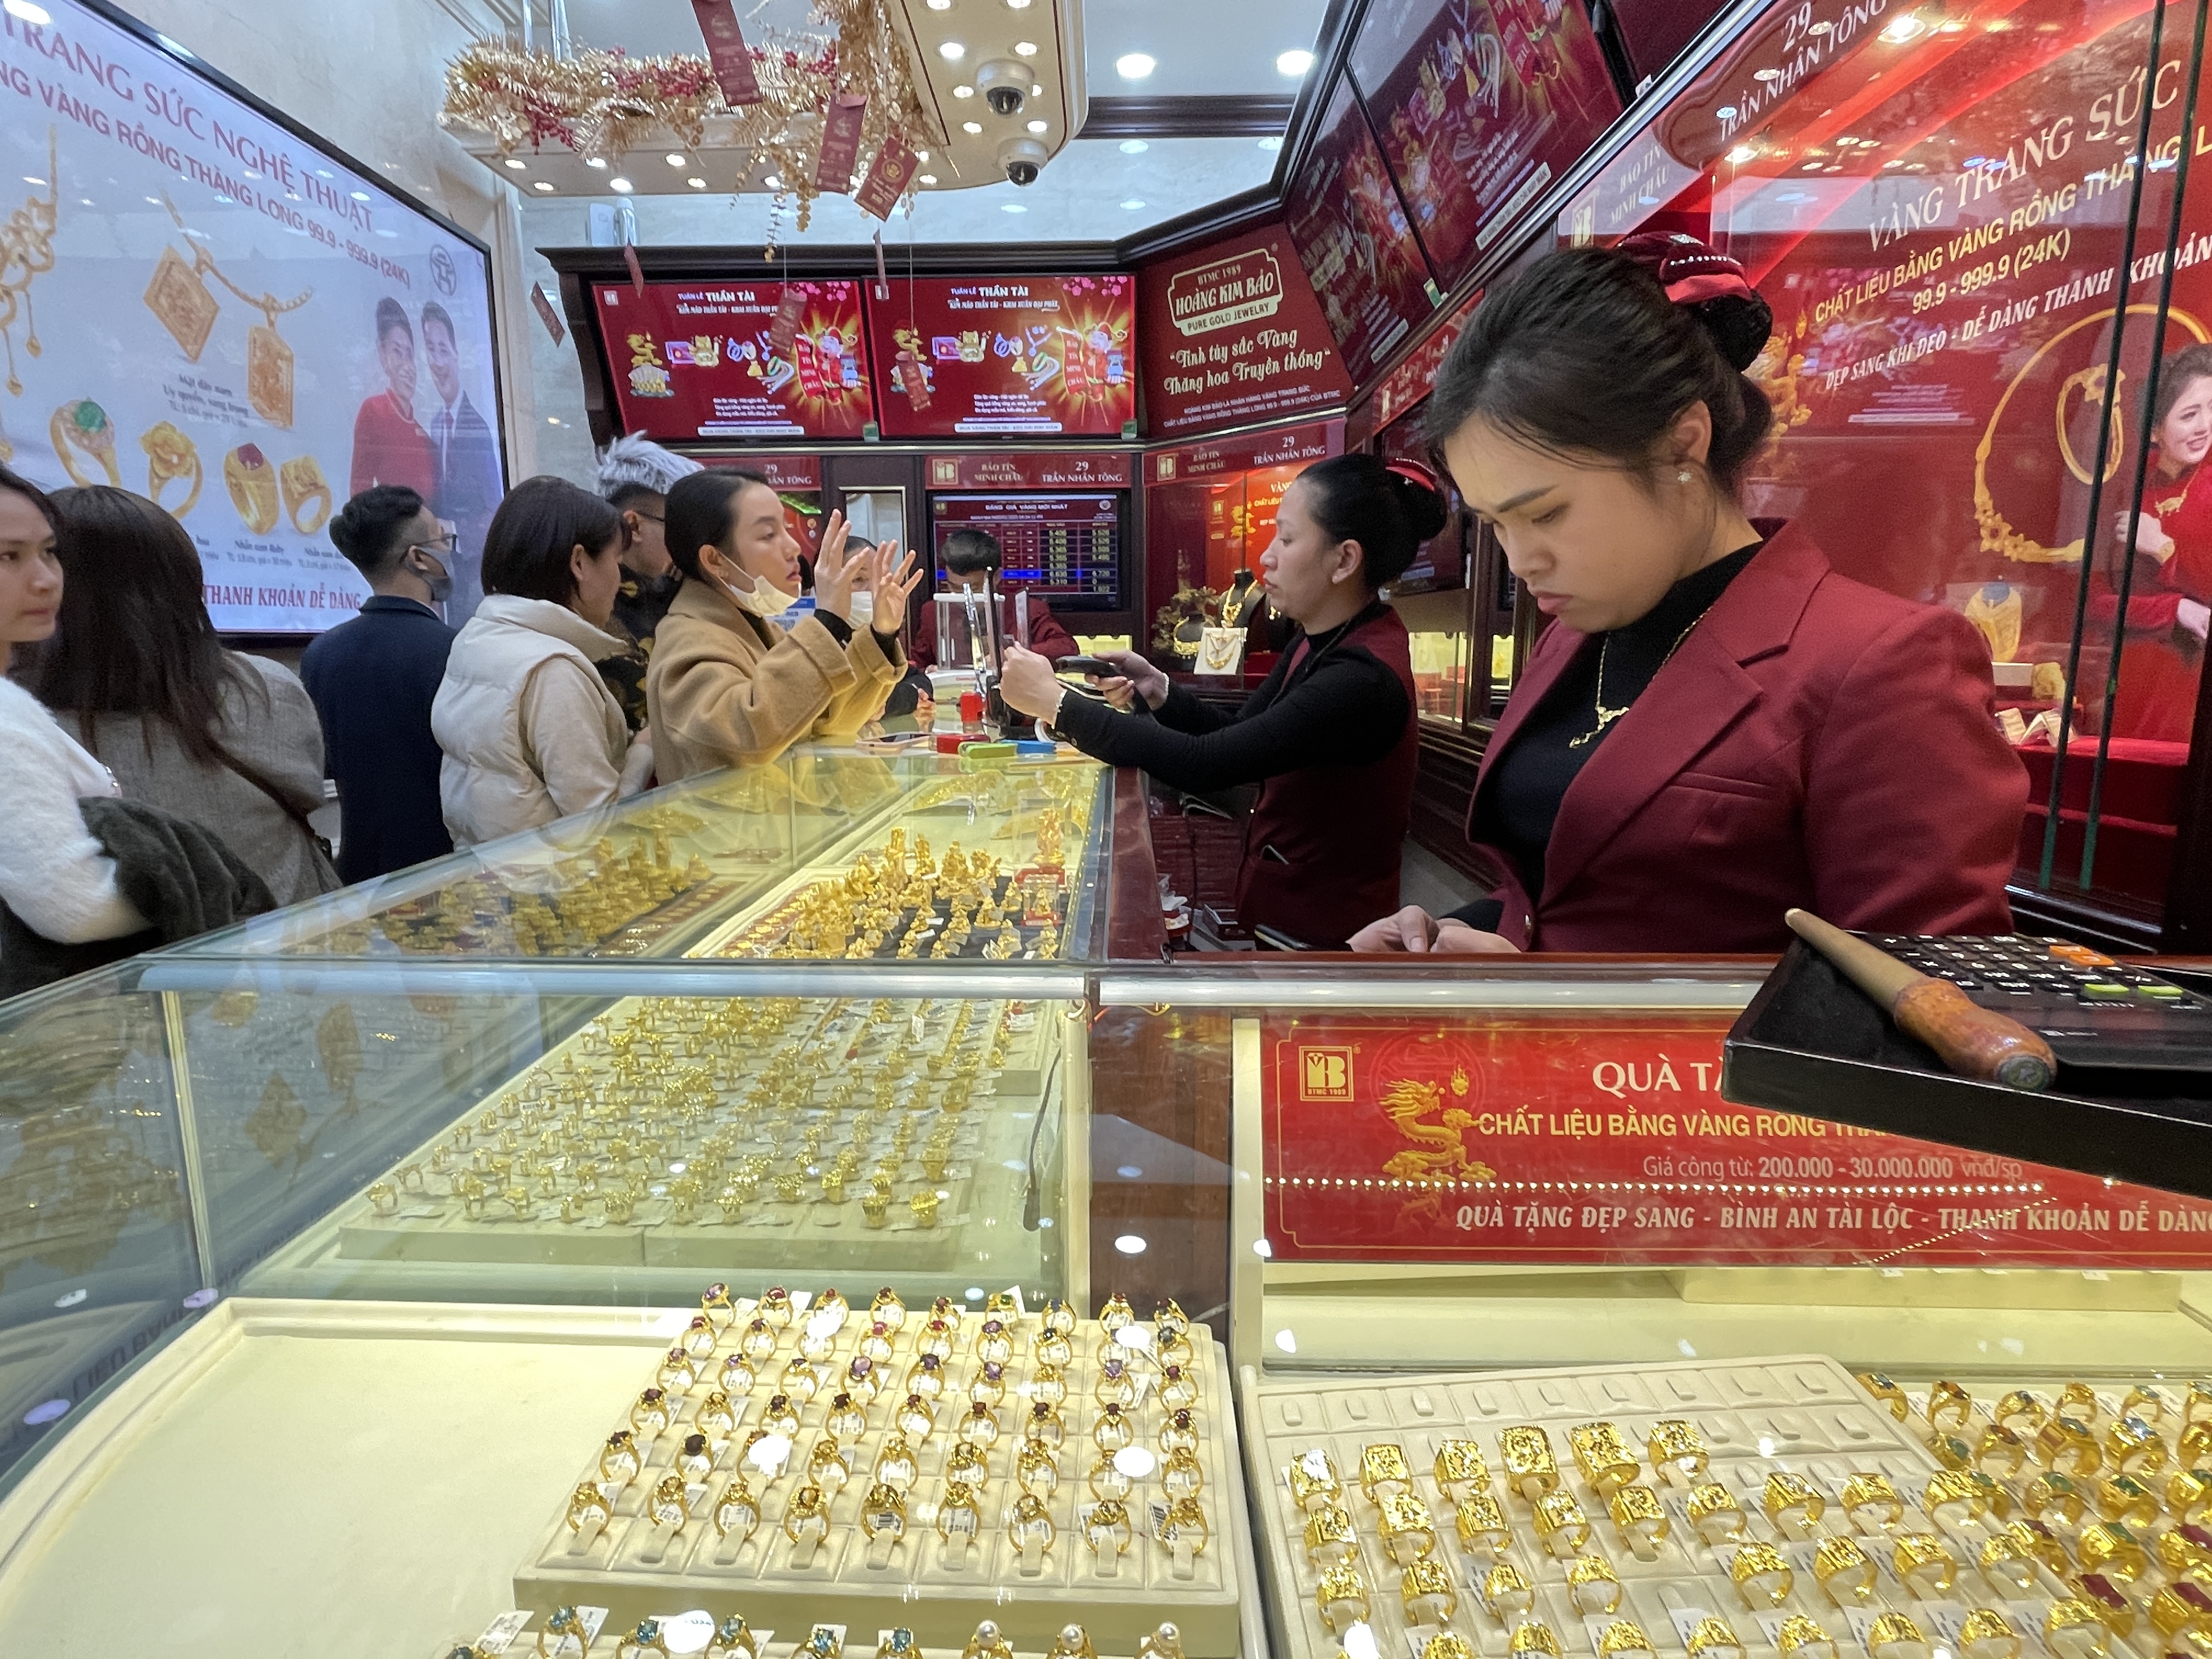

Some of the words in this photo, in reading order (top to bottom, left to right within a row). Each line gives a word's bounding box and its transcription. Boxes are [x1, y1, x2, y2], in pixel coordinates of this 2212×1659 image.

[1783, 2, 1812, 53] 29
[1765, 38, 1820, 105] NHÂN
[143, 82, 205, 140] SỨC
[213, 120, 295, 193] NGHỆ
[1869, 187, 1943, 252] VÀNG
[1955, 116, 2074, 209] TRANG
[2085, 59, 2181, 142] SỨC
[37, 78, 110, 137] VÀNG
[116, 119, 181, 171] RỒNG
[257, 193, 304, 230] LONG
[307, 219, 335, 249] 99.9
[346, 239, 378, 270] 999.9
[381, 256, 411, 291] (24K)
[1815, 284, 1852, 323] CHẤT
[1856, 270, 1891, 305] LIỆU
[1894, 247, 1943, 287] BẰNG
[1948, 218, 2004, 262] VÀNG
[2009, 183, 2077, 236] RỒNG
[1222, 264, 1242, 278] 1989
[1912, 282, 1946, 315] 99.9
[1961, 254, 2010, 296] 999.9
[2014, 228, 2071, 279] (24K)
[1011, 284, 1029, 296] TÀI
[1176, 287, 1217, 316] HOÀNG
[1220, 281, 1244, 304] KIM
[1246, 268, 1273, 297] BẢO
[1187, 319, 1208, 332] PURE
[1209, 313, 1231, 325] GOLD
[1234, 302, 1269, 320] JEWELRY
[1850, 353, 1884, 380] SANG
[1887, 342, 1914, 368] KHI
[1988, 296, 2039, 332] DÀNG
[2044, 267, 2115, 313] THANH
[1206, 370, 1229, 387] hoa
[1276, 449, 1300, 462] NHÂN
[1302, 444, 1325, 458] TÔNG
[1282, 436, 1295, 448] 29
[764, 464, 778, 474] 29
[787, 475, 812, 484] TÔNG
[1042, 471, 1066, 482] TRẦN
[1068, 472, 1095, 482] NHÂN
[1098, 472, 1122, 482] TÔNG
[1075, 461, 1089, 472] 29
[1271, 481, 1293, 493] VÀN
[203, 584, 253, 605] THANH
[1592, 1053, 1681, 1099] QUÀ
[1479, 1105, 1543, 1136] CHẤT
[1550, 1108, 1602, 1141] LIỆU
[1608, 1105, 1677, 1136] BẰNG
[1683, 1108, 1751, 1137] VÀNG
[1643, 1155, 1673, 1177] Giá
[1678, 1156, 1725, 1182] công
[1758, 1157, 1833, 1178] 200.000
[1850, 1156, 1954, 1178] 30.000.000
[1456, 1199, 1504, 1231] QUÀ
[1513, 1201, 1572, 1234] TẶNG
[1581, 1206, 1627, 1234] ĐẸP
[1634, 1206, 1695, 1229] SANG
[1720, 1201, 1778, 1229] BÌNH
[1785, 1207, 1818, 1229] AN
[1826, 1201, 1863, 1229] TÀI
[1871, 1202, 1914, 1234] LỘC
[1938, 1208, 2019, 1229] THANH
[2027, 1202, 2110, 1232] KHOẢN
[2119, 1200, 2150, 1232] DỄ
[2158, 1204, 2212, 1232] DÀN
